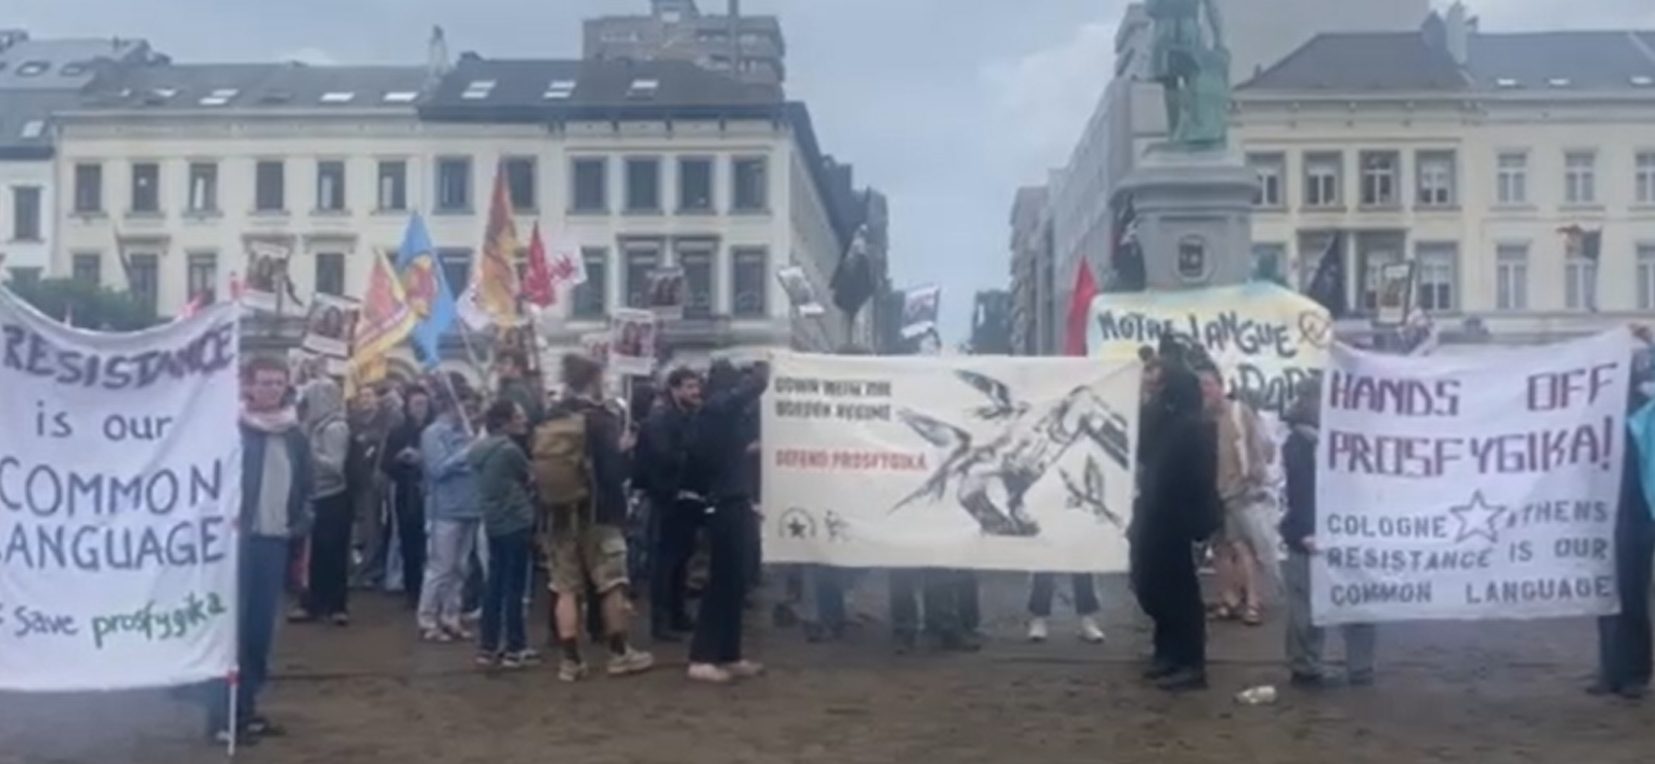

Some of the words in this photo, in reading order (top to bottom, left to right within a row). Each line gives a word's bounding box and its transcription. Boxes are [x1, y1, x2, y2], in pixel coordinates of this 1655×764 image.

[1329, 370, 1462, 417] HANDS
[1526, 361, 1619, 412] OFF
[36, 401, 73, 438] is
[102, 413, 173, 442] our
[1328, 415, 1614, 479] PROSFYGIKA!
[0, 455, 222, 518] COMMON
[0, 516, 225, 571] ANGUAGE
[1326, 513, 1448, 539] COLOGNE
[1326, 547, 1494, 571] RESISTANCE
[1508, 541, 1534, 563] IS
[1555, 537, 1609, 562] OUR
[1330, 581, 1433, 606] COMMON
[1465, 575, 1614, 604] LANGUAGE
